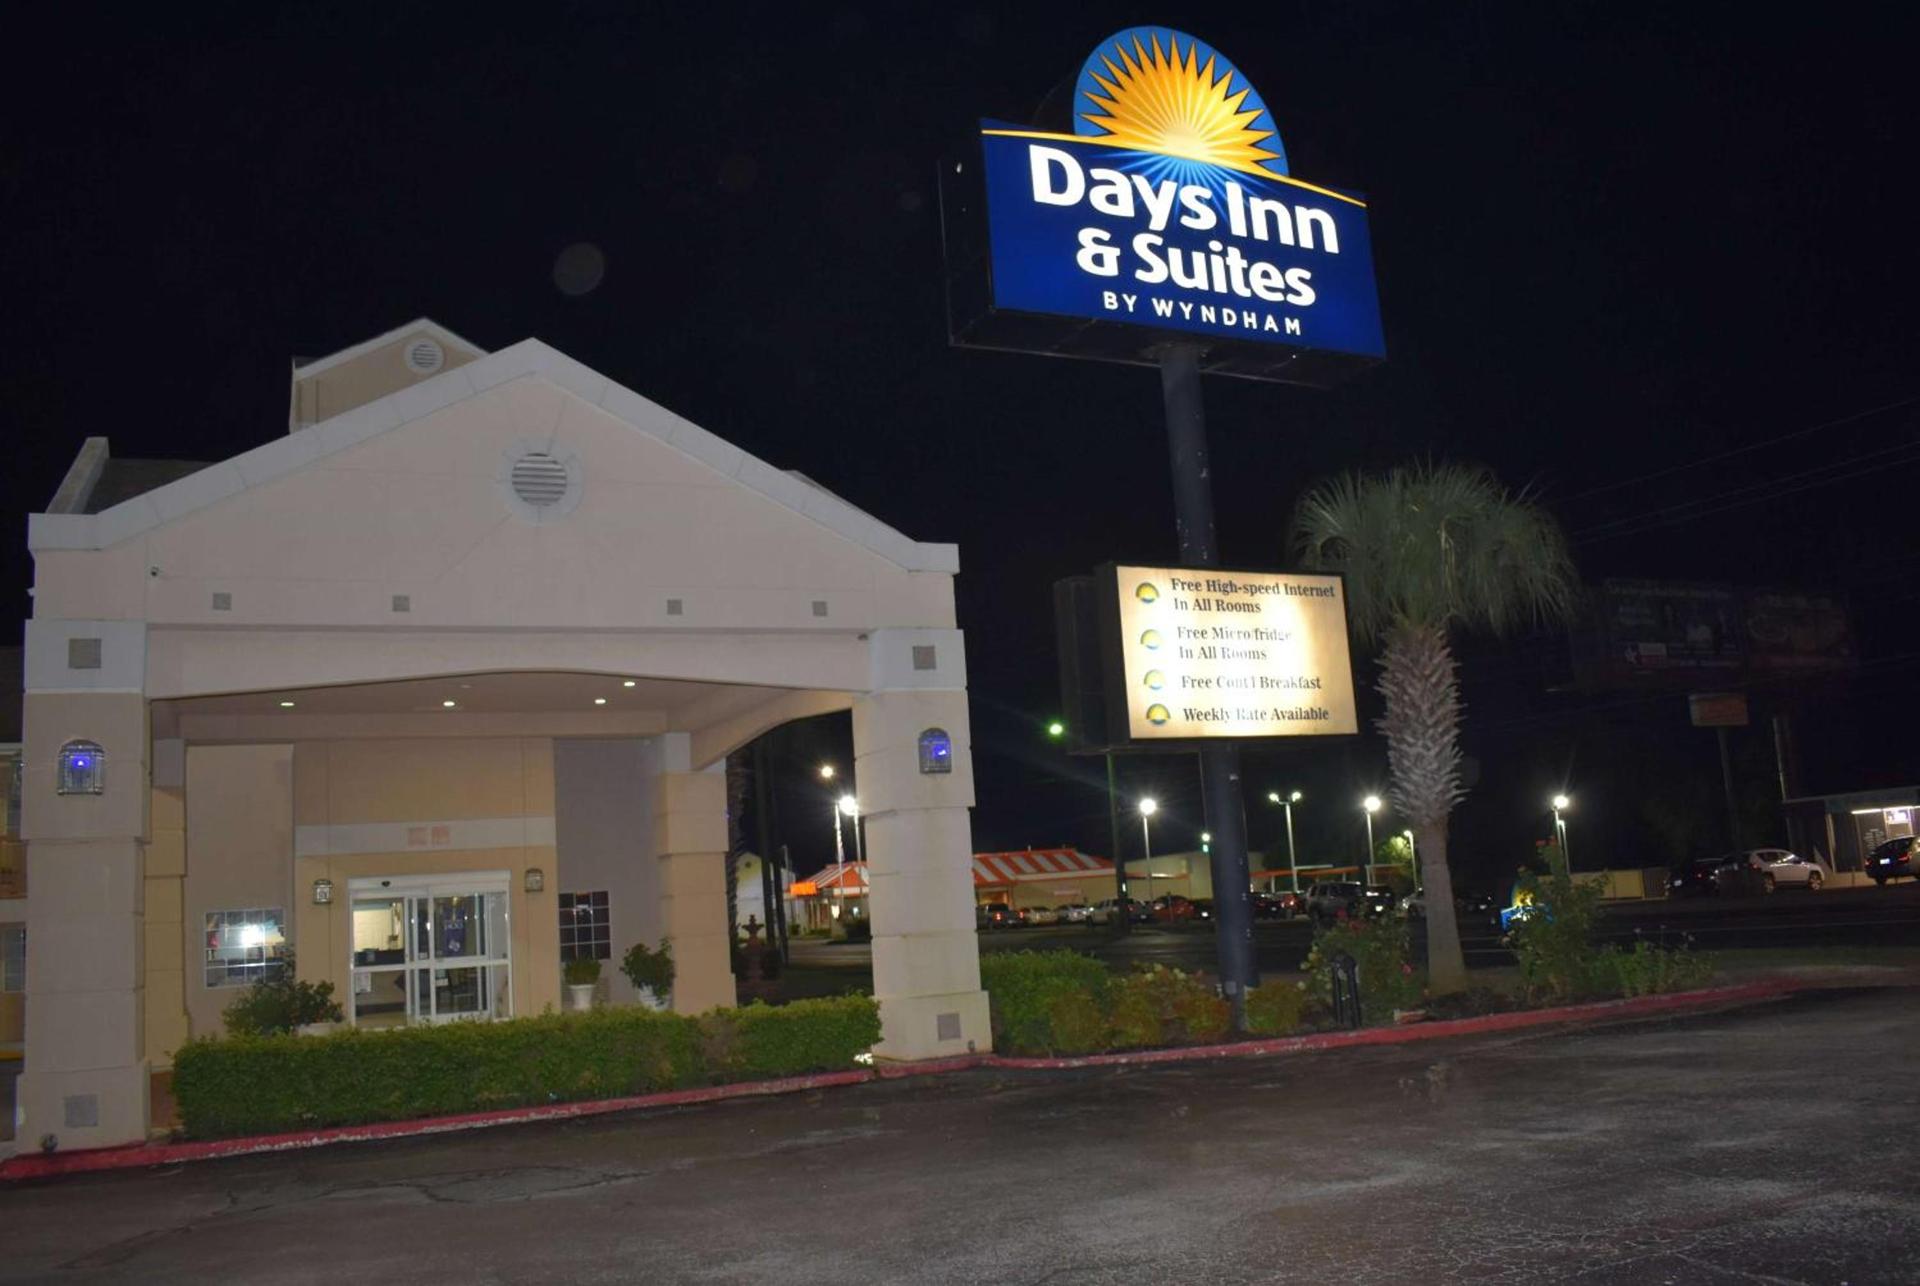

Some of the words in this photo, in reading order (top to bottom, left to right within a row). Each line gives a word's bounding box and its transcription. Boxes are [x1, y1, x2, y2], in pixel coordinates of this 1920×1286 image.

[1029, 144, 1218, 232] Days
[1226, 180, 1340, 254] Inn
[1075, 227, 1121, 277] &
[1132, 233, 1317, 307] Suites
[1103, 291, 1137, 313] BY
[1151, 298, 1302, 336] WYNDHAM
[1171, 578, 1202, 592] Free
[1206, 579, 1281, 597] High-speed
[1284, 583, 1336, 598] Internet
[1174, 598, 1188, 611] In
[1193, 598, 1212, 612] All
[1216, 599, 1262, 613] Rooms
[1177, 626, 1208, 640] Free
[1179, 645, 1194, 660] In
[1197, 645, 1217, 660] All
[1221, 647, 1268, 661] Rooms
[1181, 675, 1213, 689] Free
[1216, 675, 1256, 689] Contl
[1260, 676, 1322, 689] Breakfast
[1183, 708, 1230, 723] Weekly
[1236, 708, 1267, 721] Rate
[1270, 707, 1330, 721] Available
